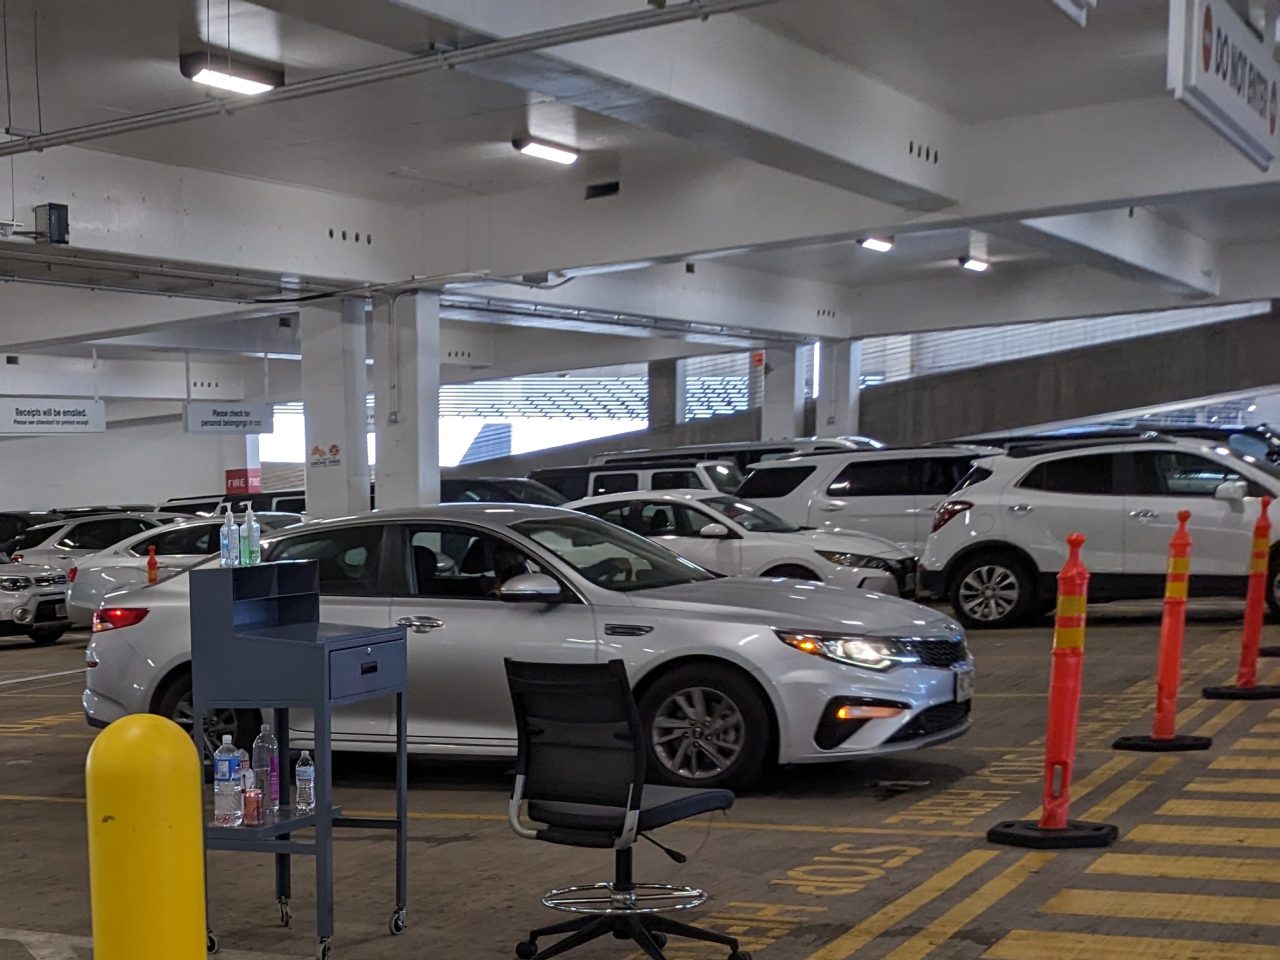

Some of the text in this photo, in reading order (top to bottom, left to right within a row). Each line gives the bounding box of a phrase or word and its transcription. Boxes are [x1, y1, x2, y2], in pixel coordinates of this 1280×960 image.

[15, 407, 41, 417] Receipts
[42, 408, 52, 416] will
[53, 408, 61, 416] be
[212, 409, 227, 417] Please
[229, 409, 243, 417] check
[228, 478, 245, 487] FIRE
[770, 843, 922, 896] STOP
